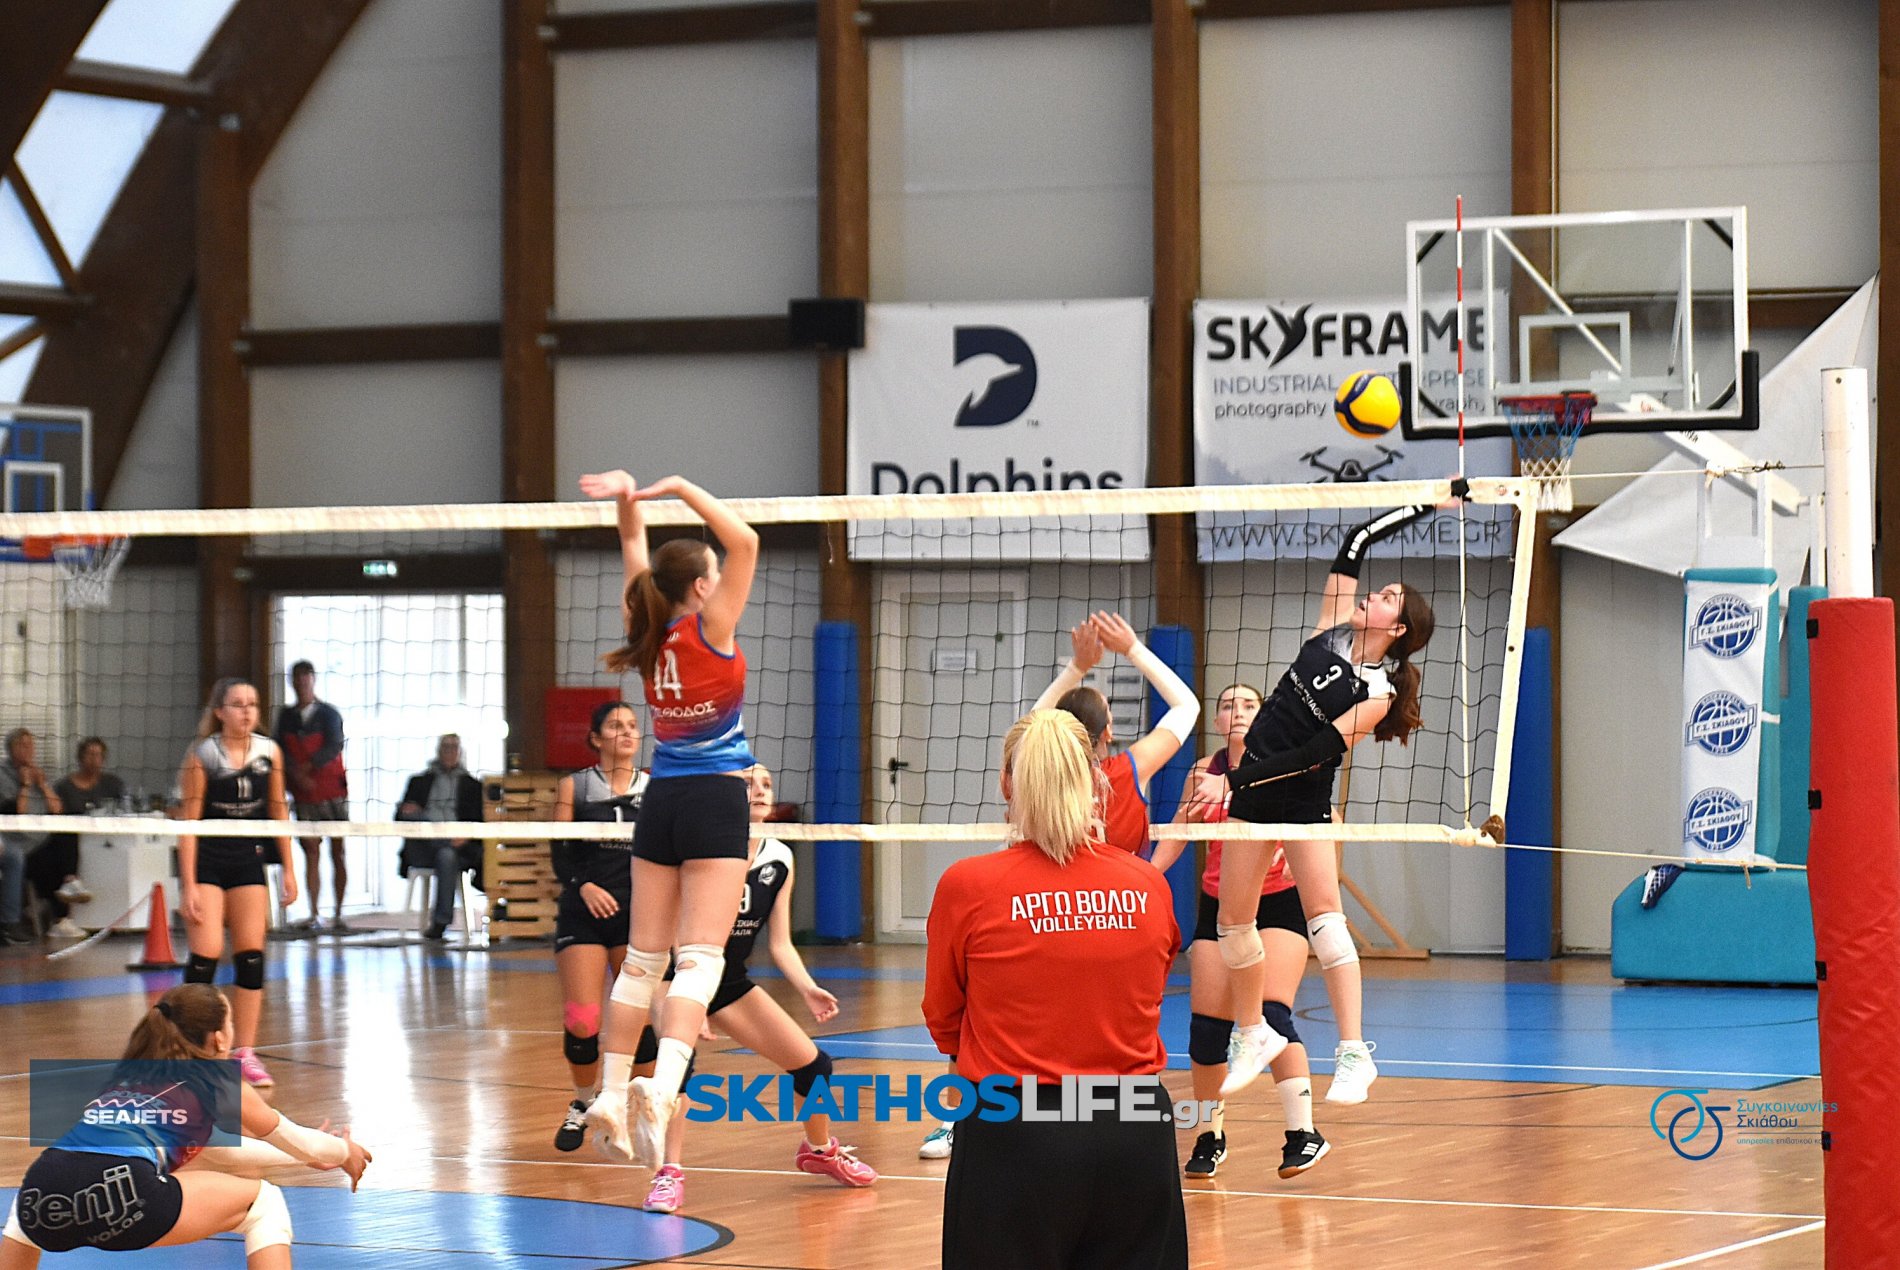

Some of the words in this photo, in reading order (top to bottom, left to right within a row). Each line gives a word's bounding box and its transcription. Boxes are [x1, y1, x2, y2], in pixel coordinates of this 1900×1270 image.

[1207, 303, 1484, 369] SKYFRAME
[1213, 374, 1338, 395] INDUSTRIAL
[1214, 402, 1327, 421] photography
[1212, 521, 1501, 549] WWW.SKYAME.GR
[654, 649, 682, 700] 14
[1312, 664, 1343, 690] 3
[650, 700, 716, 718] ΕΘΟΔΟΣ
[1011, 891, 1072, 921] ΑΡΓΩ
[1075, 889, 1148, 915] ΒΟΛΟΥ
[1030, 914, 1137, 934] VOLLEYBALL
[21, 1164, 138, 1230] Benji
